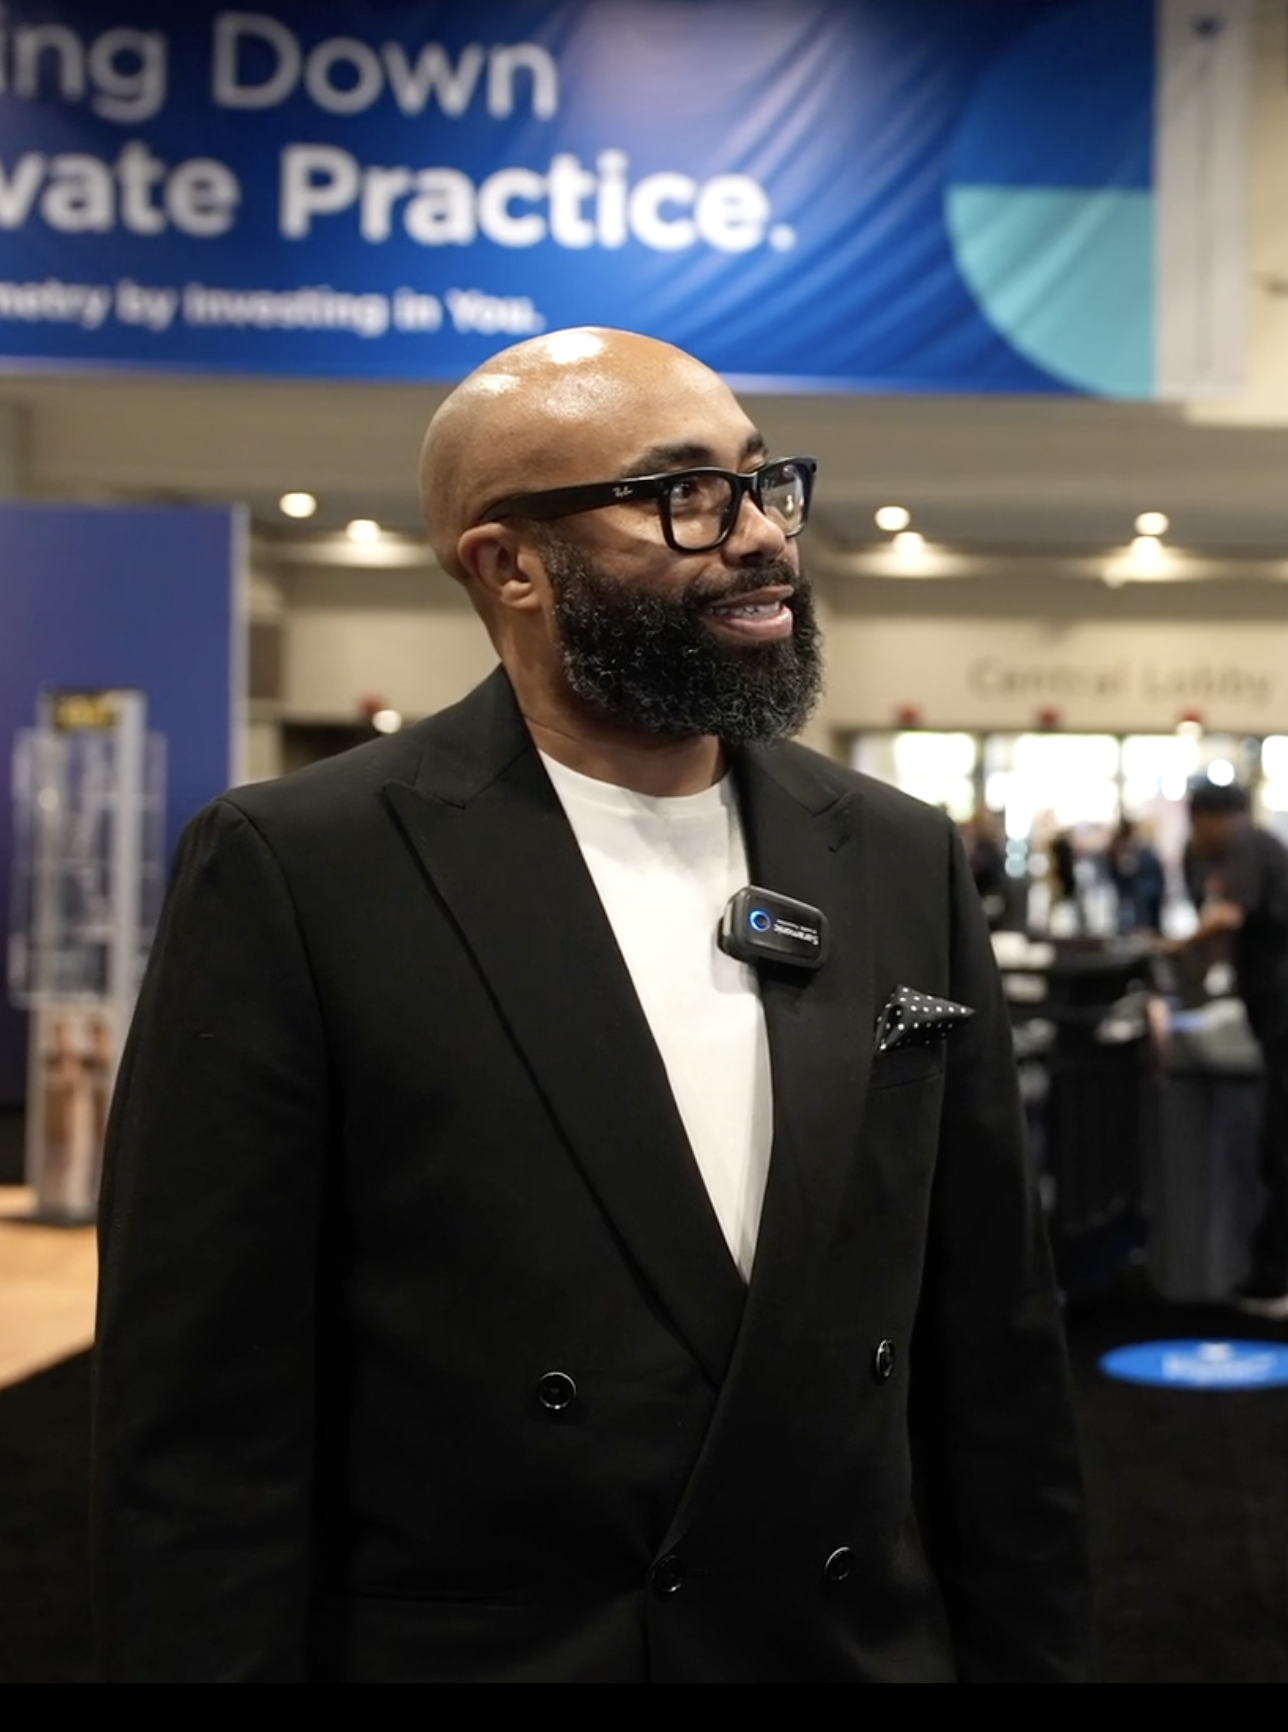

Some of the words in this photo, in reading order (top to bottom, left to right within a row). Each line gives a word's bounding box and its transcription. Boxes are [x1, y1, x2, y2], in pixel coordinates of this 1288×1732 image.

[213, 11, 557, 119] Down
[281, 143, 796, 253] Practice.
[115, 277, 179, 332] by
[394, 285, 444, 334] in
[446, 287, 547, 336] You.
[969, 657, 1131, 697] Central
[1144, 659, 1279, 703] Lobby
